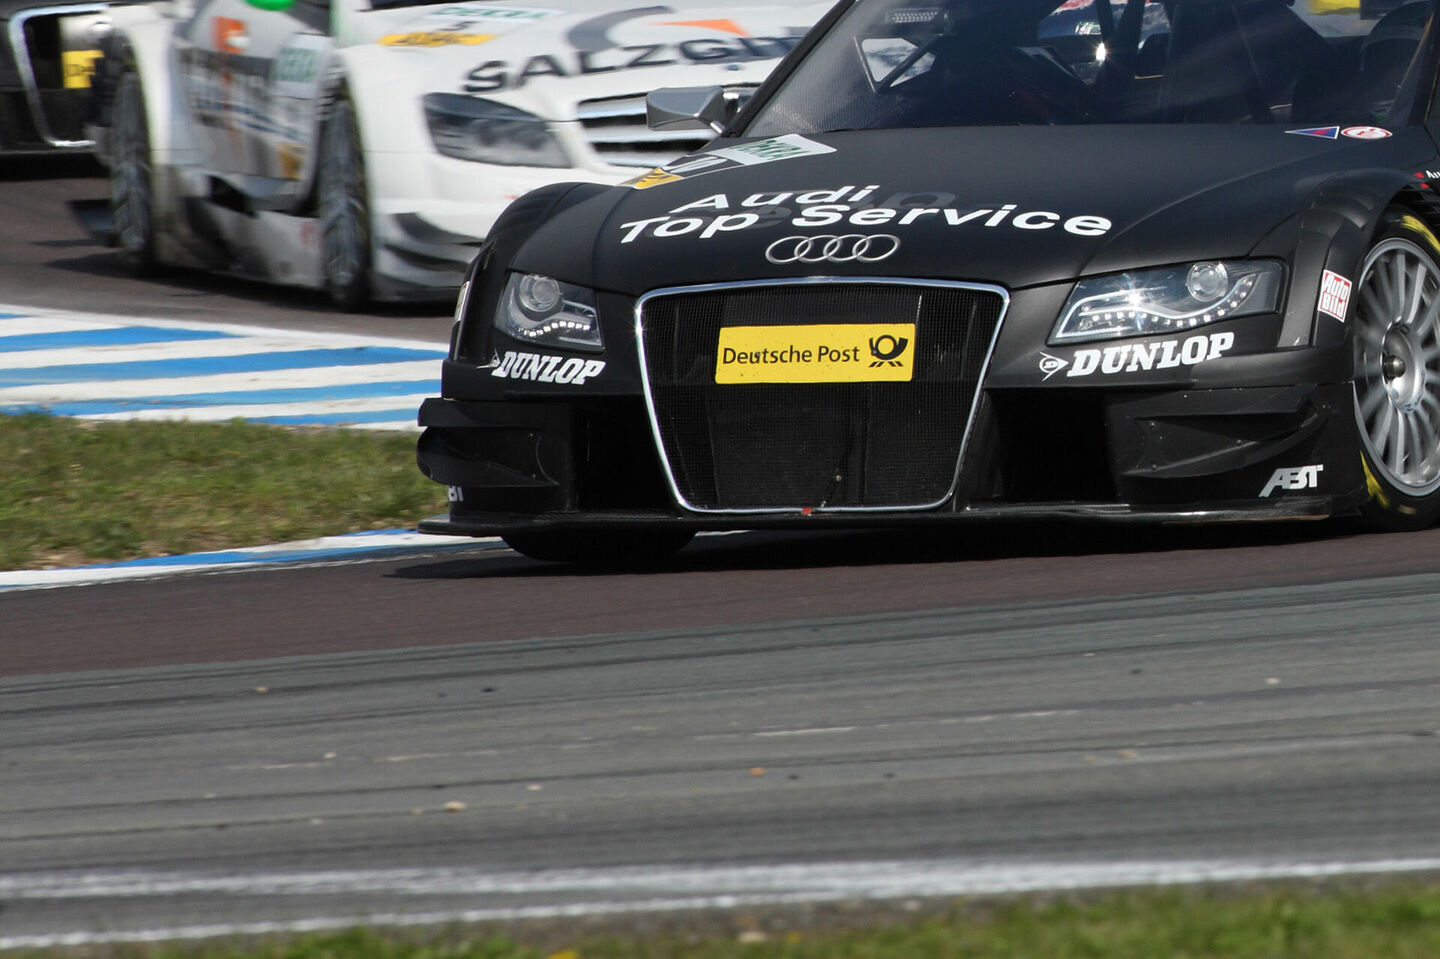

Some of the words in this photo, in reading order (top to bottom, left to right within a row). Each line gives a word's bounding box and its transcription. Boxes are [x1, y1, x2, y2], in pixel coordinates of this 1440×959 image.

[669, 184, 881, 214] Audi
[619, 212, 760, 244] Top
[792, 203, 1113, 237] Service
[1323, 273, 1350, 300] Auto
[1321, 294, 1347, 319] Bild
[491, 350, 607, 385] DUNLOP
[721, 344, 814, 367] Deutsche
[817, 344, 861, 364] Post
[1066, 331, 1235, 378] DUNLOP
[1258, 463, 1324, 498] ABT
